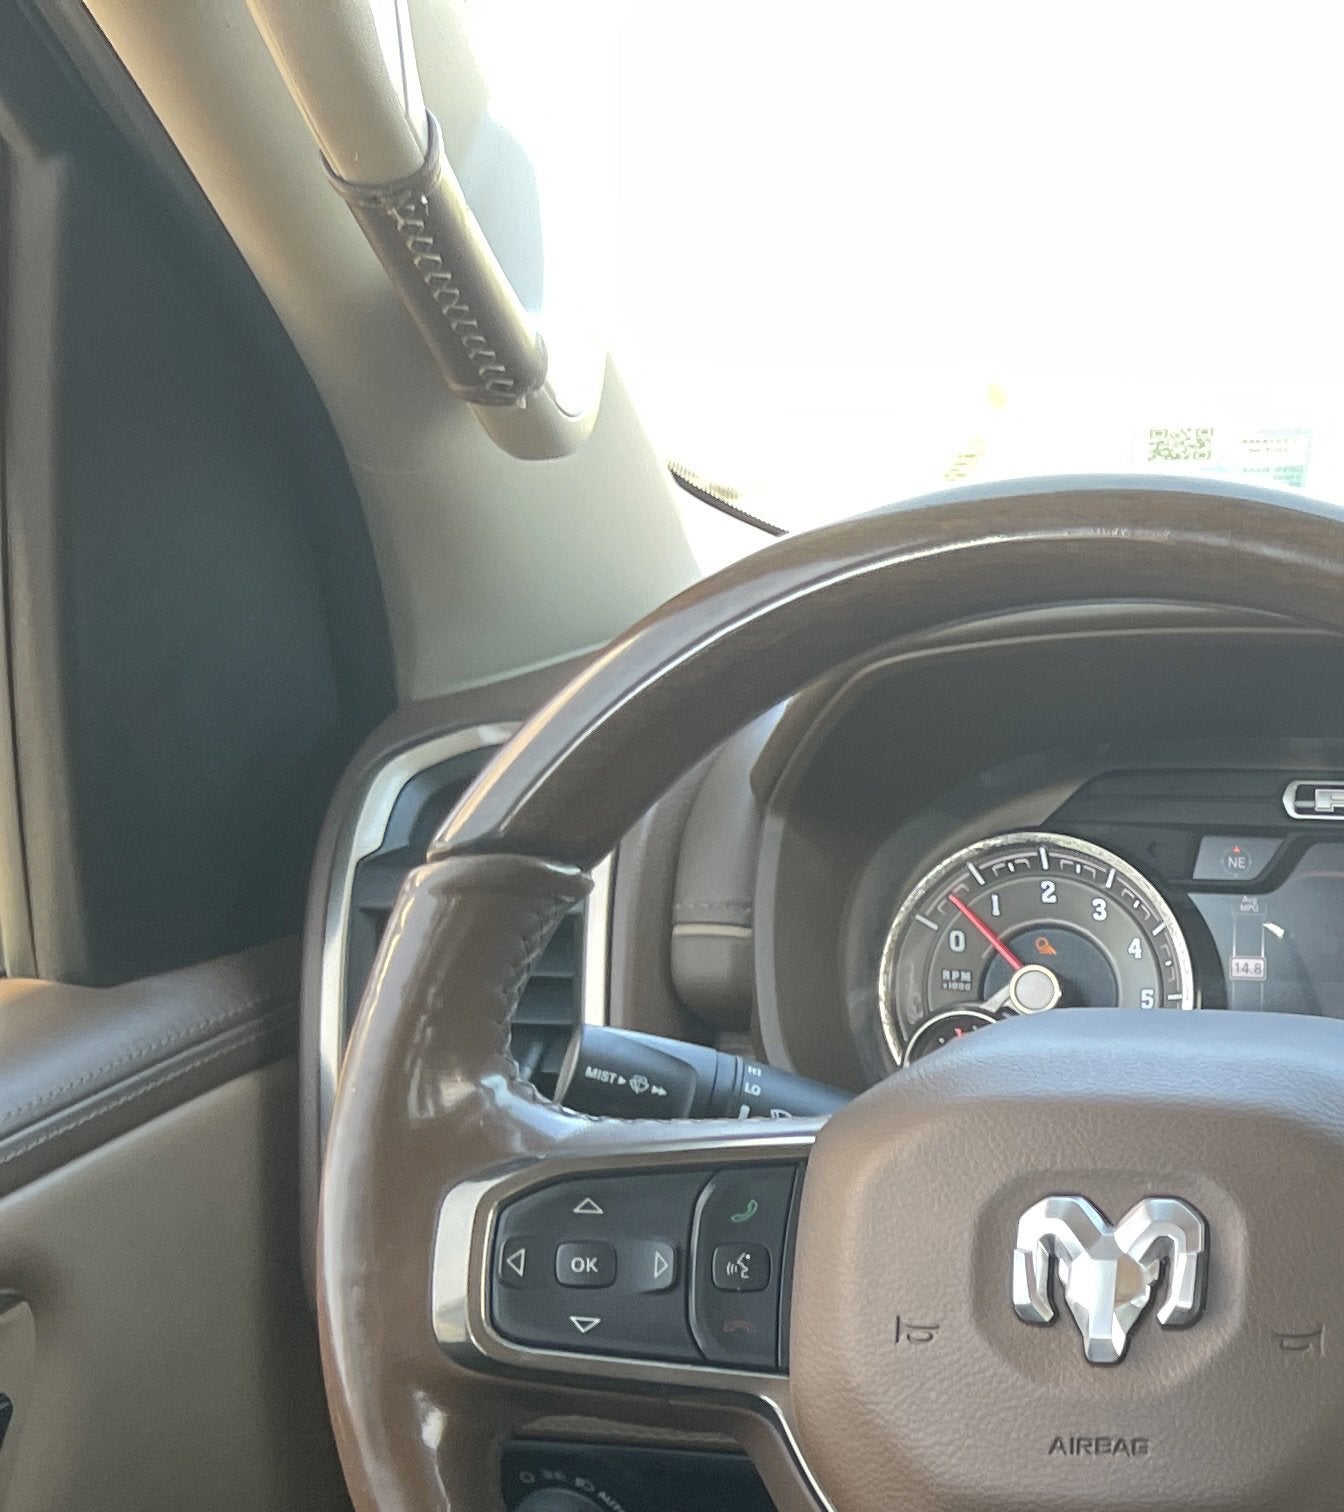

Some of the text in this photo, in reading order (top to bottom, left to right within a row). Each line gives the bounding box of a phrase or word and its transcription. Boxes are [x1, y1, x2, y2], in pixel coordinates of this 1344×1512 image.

[1228, 856, 1246, 869] NE
[1040, 881, 1057, 903] 2
[991, 894, 1000, 916] 1
[1092, 898, 1107, 921] 3
[950, 931, 965, 952] 0
[1128, 938, 1142, 958] 4
[943, 969, 971, 982] RPM
[1235, 963, 1261, 975] 14.8
[1141, 989, 1154, 1010] 5
[585, 1066, 617, 1084] MIST
[571, 1256, 598, 1273] OK
[1047, 1436, 1149, 1457] AIRBAG
